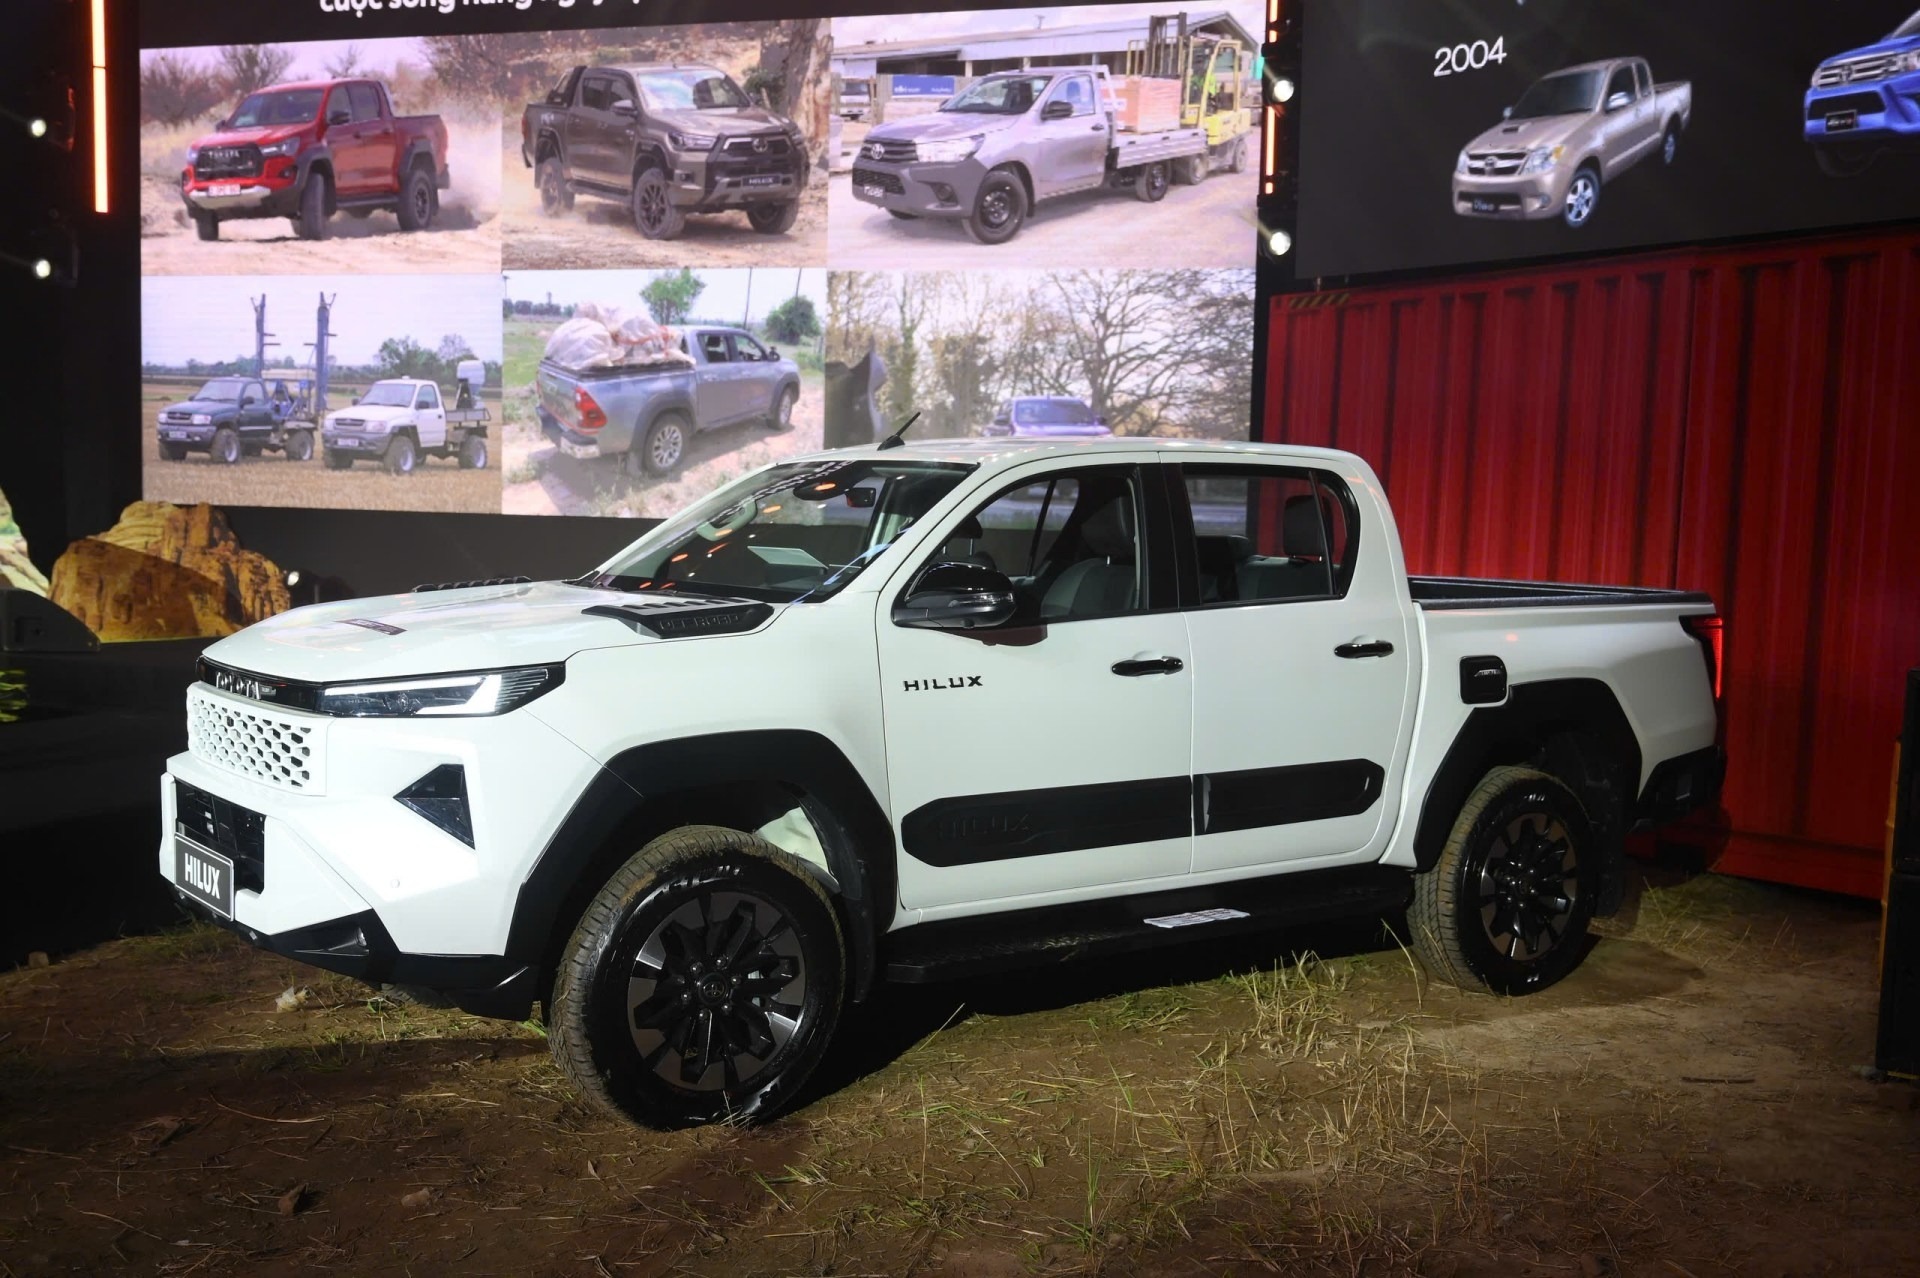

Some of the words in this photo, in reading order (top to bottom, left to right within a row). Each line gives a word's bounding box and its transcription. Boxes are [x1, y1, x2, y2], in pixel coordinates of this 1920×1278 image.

[1434, 35, 1507, 77] 2004
[902, 675, 983, 692] HILUX
[184, 852, 220, 900] HILUX
